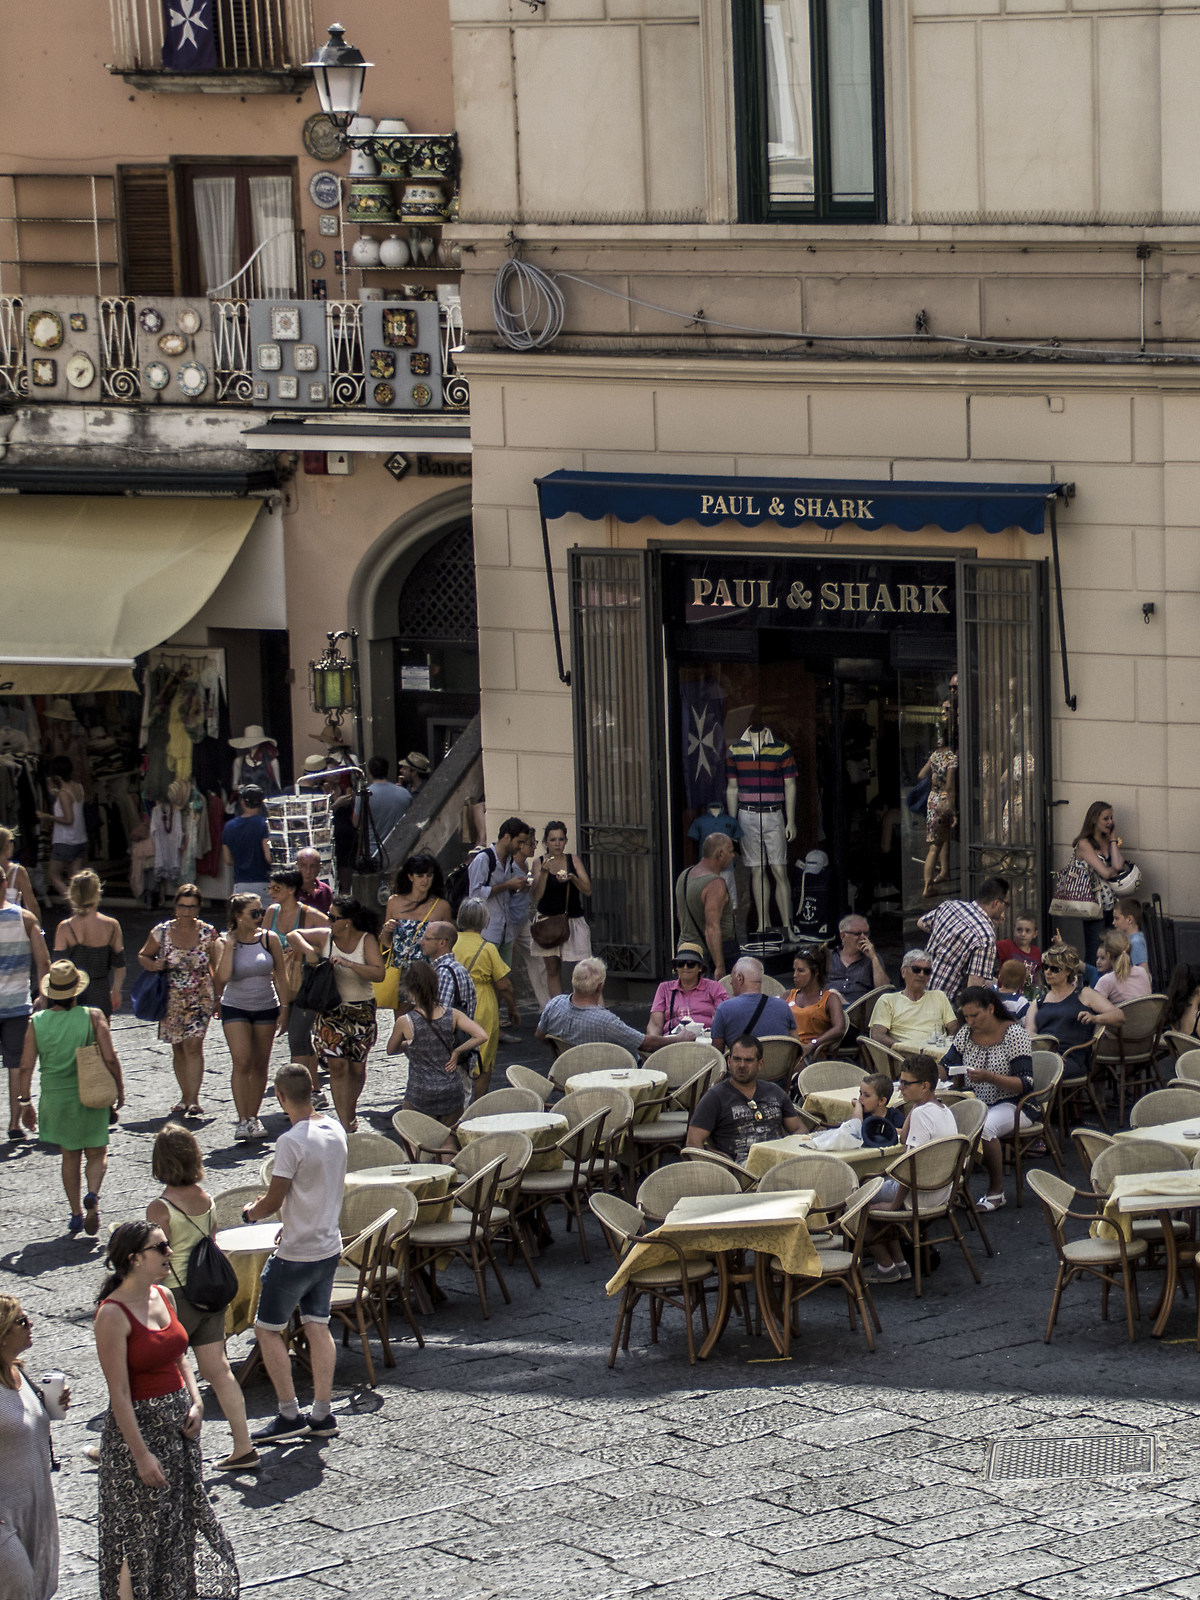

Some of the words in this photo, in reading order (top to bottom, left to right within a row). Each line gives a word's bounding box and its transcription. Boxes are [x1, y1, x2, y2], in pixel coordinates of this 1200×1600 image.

[700, 495, 760, 516] PAUL
[768, 496, 785, 516] &
[794, 498, 874, 519] SHARK
[691, 578, 778, 608] PAUL
[786, 581, 812, 610] &
[820, 583, 950, 614] SHARK
